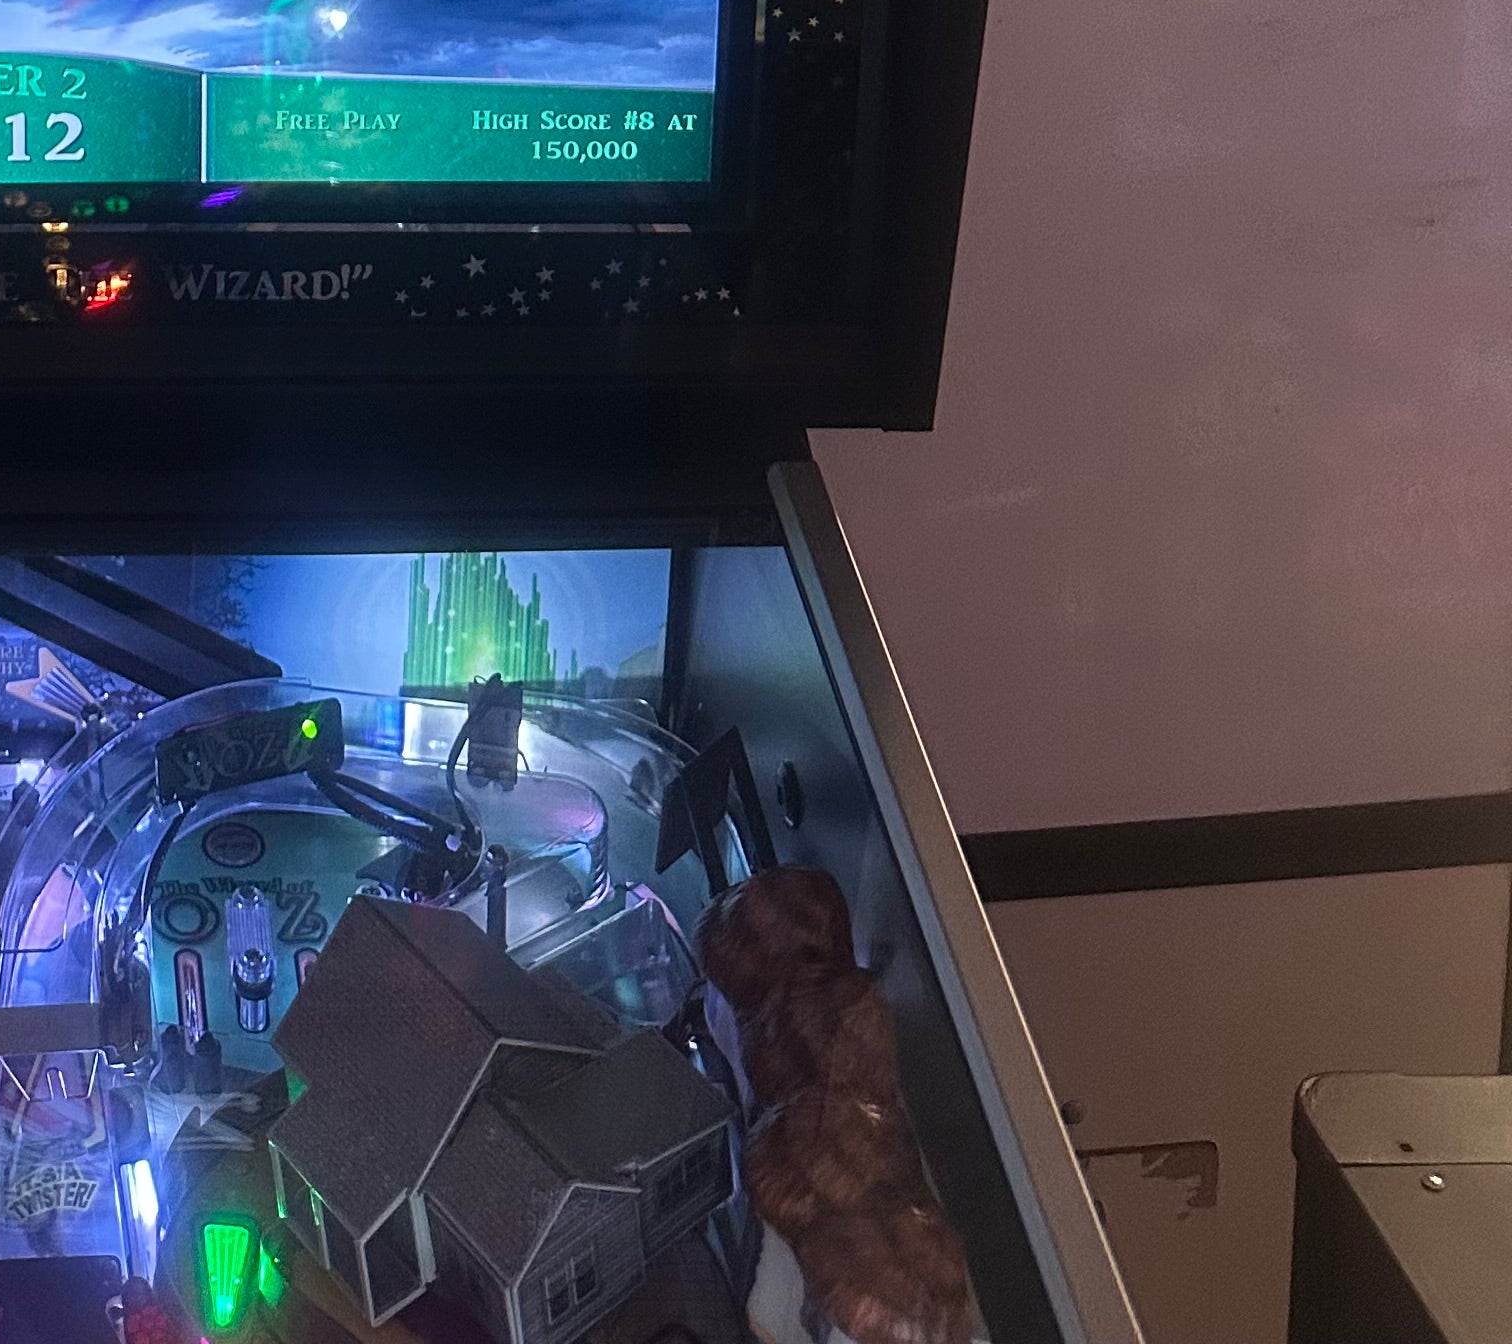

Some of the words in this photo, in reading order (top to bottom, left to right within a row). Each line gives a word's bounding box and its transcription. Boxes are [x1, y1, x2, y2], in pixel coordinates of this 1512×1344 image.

[61, 66, 88, 100] 2
[623, 110, 656, 131] #8
[531, 139, 639, 164] 150,000
[7, 1181, 98, 1220] TWISTER!
